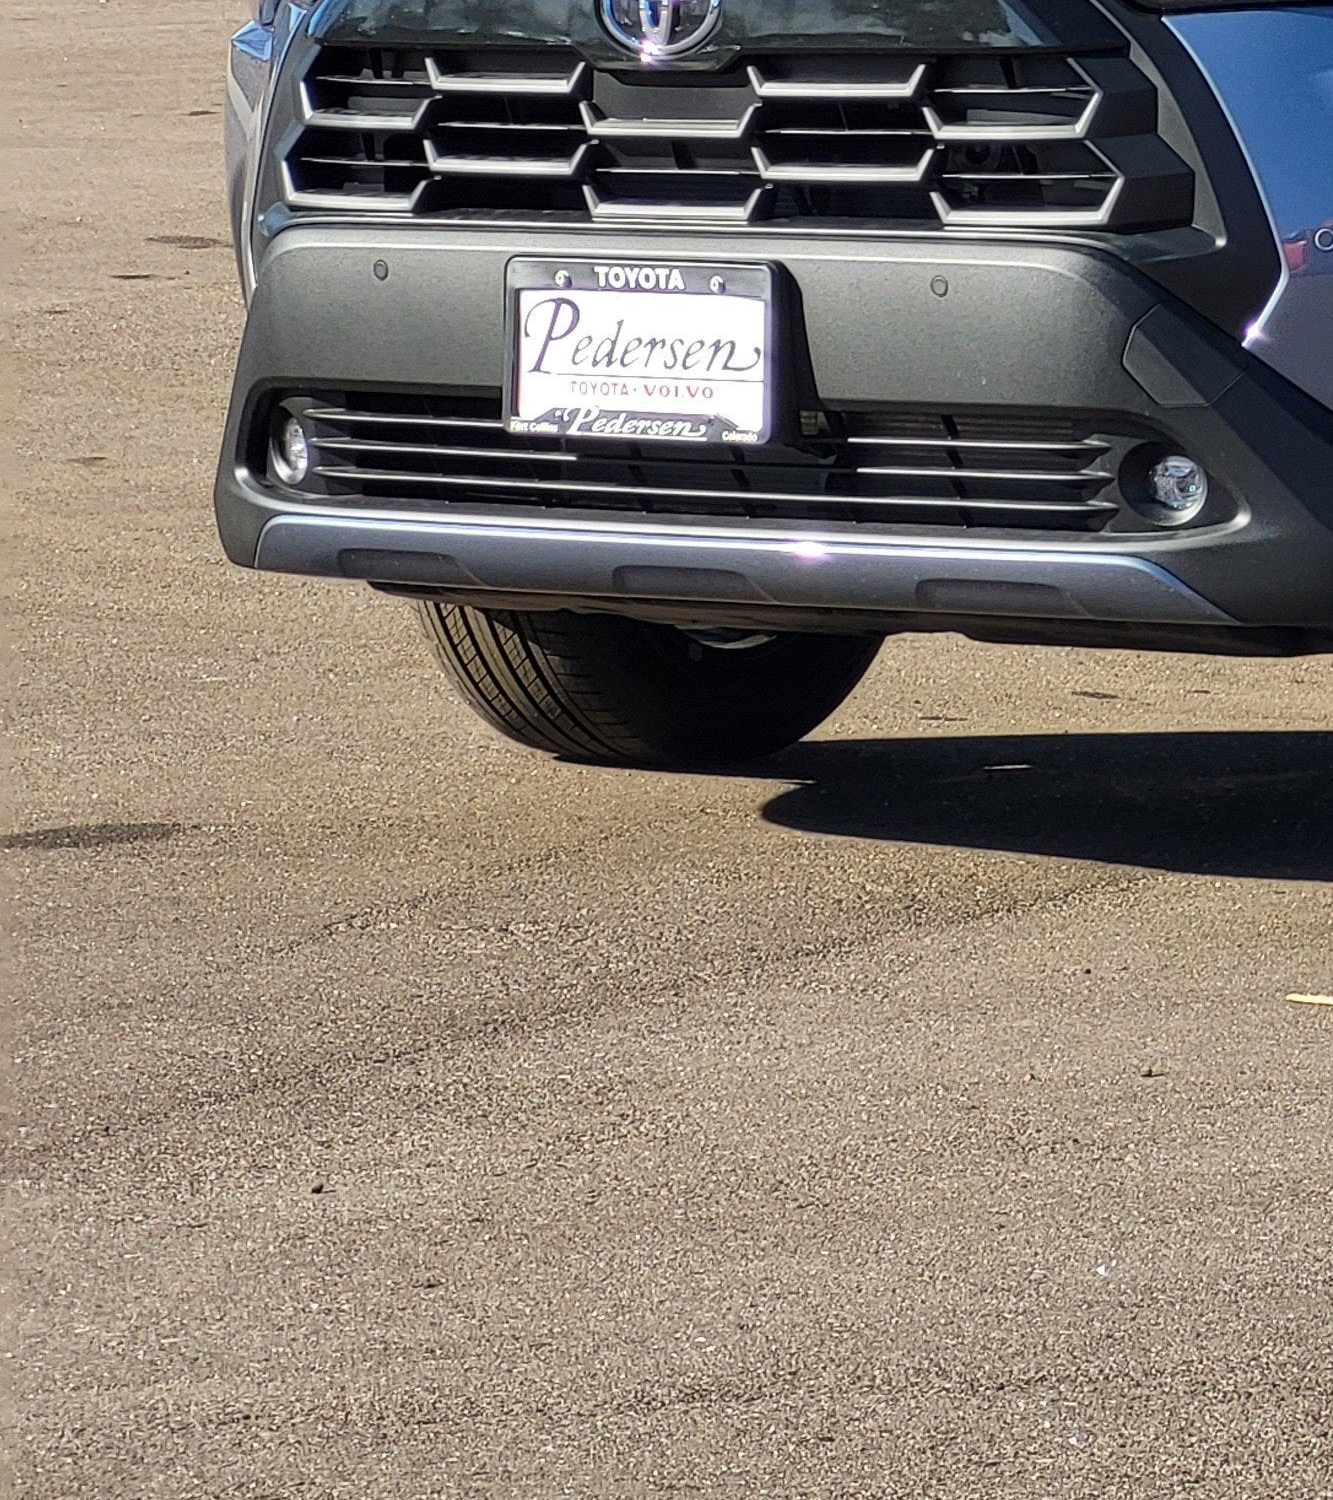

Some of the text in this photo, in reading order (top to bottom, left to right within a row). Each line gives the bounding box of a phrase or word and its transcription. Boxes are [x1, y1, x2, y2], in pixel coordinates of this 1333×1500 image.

[593, 266, 686, 290] TOYOTA
[523, 296, 762, 375] Pedersen
[570, 380, 629, 396] TOYOTA
[564, 406, 708, 438] Pedersen
